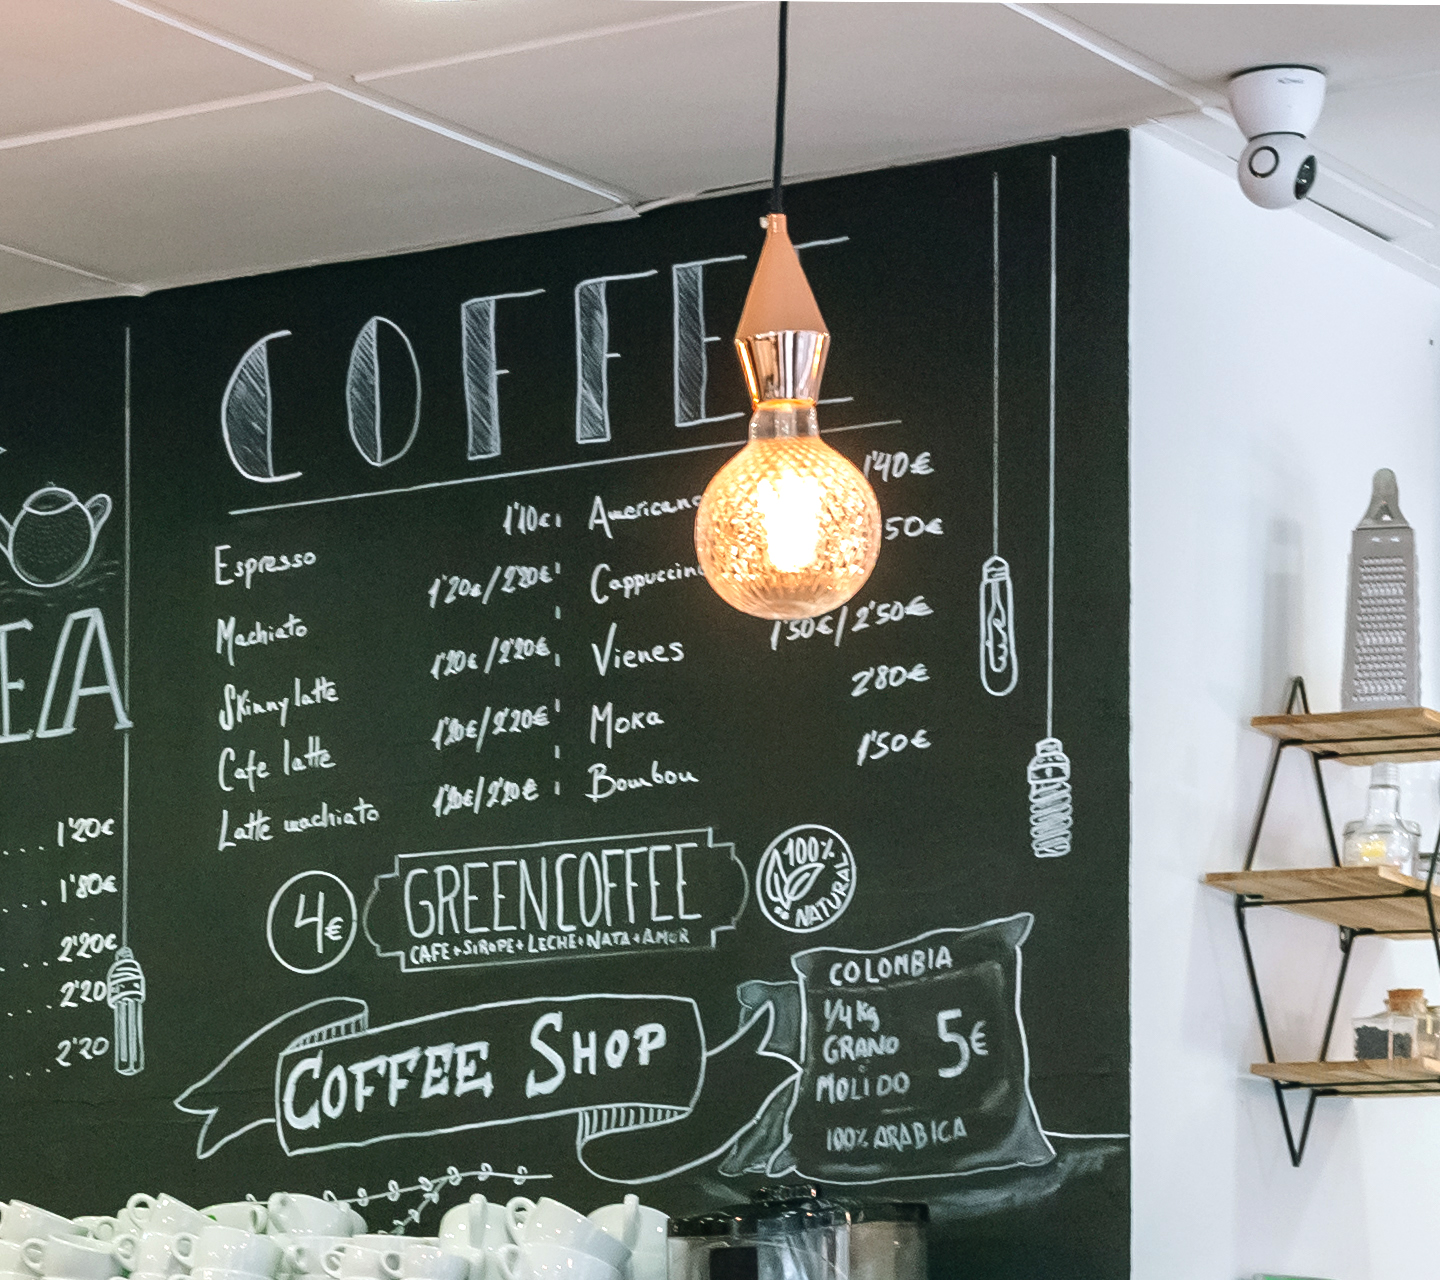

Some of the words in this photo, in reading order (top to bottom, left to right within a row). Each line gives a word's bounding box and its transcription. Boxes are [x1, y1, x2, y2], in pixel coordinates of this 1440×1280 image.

[214, 544, 318, 590] Espresso
[216, 613, 309, 667] Machiato
[590, 622, 686, 677] Vienes
[219, 683, 290, 732] Skinny
[294, 676, 340, 708] latte
[589, 701, 665, 749] Moka
[218, 746, 270, 793] Cafe
[283, 735, 337, 777] latte
[217, 809, 274, 852] Latte
[283, 796, 380, 834] machiato
[781, 835, 836, 867] 100%
[403, 842, 703, 939] GREENCOFFEE
[793, 851, 852, 929] NATURAL
[409, 942, 451, 965] CAFE
[527, 932, 577, 953] LECHE
[586, 929, 631, 950] NATA
[642, 927, 691, 945] AMOR
[828, 945, 954, 987] COLOMBIA
[822, 1034, 901, 1065] GRANO
[936, 1007, 990, 1079] 5€
[283, 1042, 495, 1132] COFFEE
[524, 1011, 668, 1100] SHOP
[815, 1071, 911, 1105] MOLIDO
[825, 1127, 868, 1152] 100%
[872, 1117, 968, 1151] ARABICA
